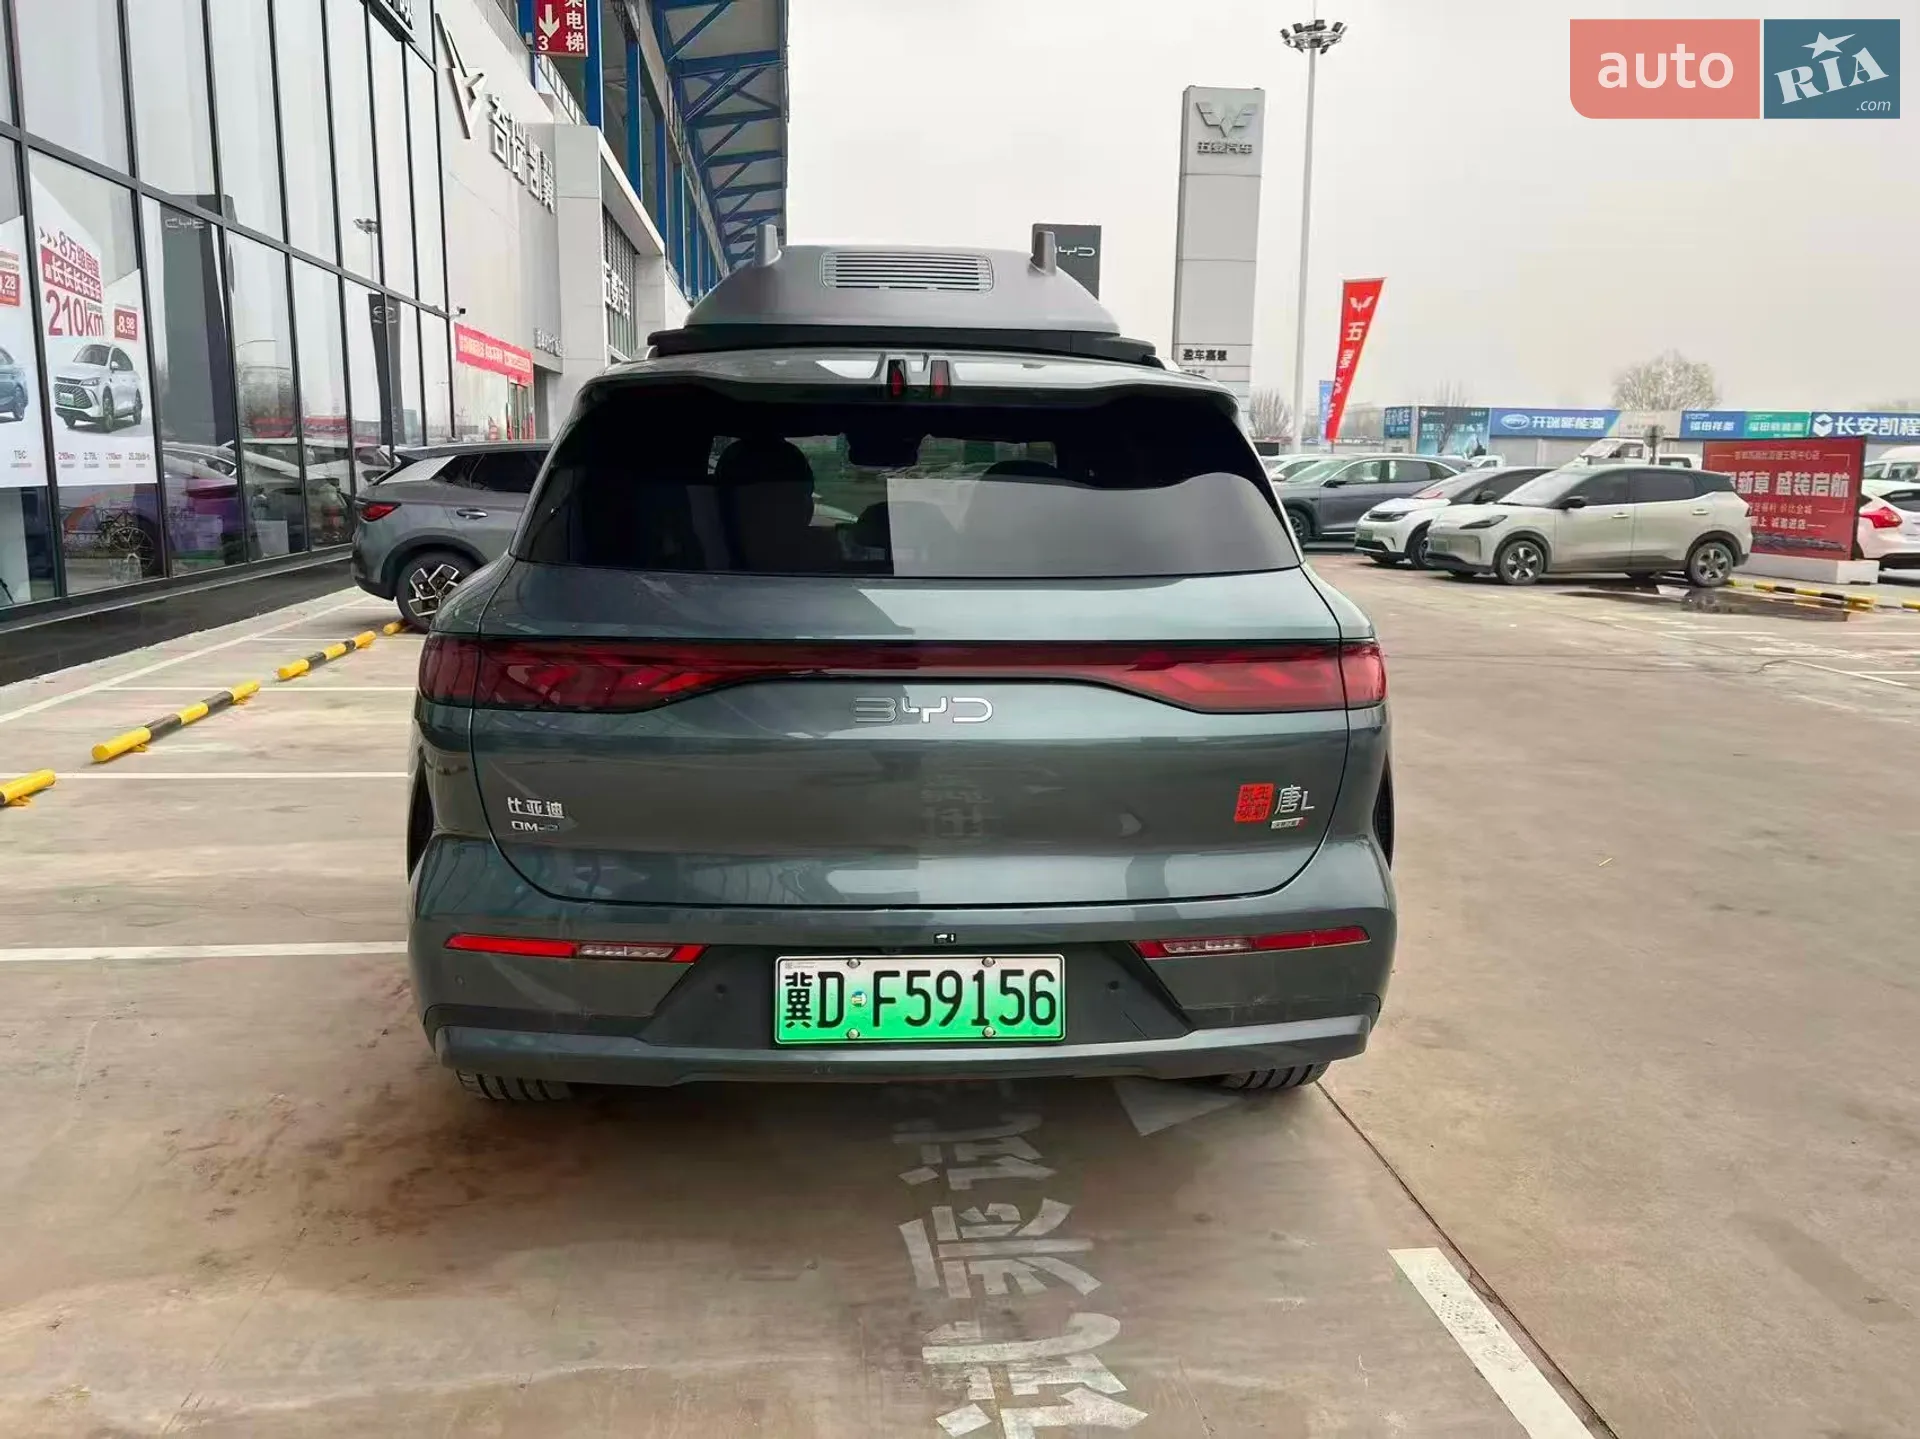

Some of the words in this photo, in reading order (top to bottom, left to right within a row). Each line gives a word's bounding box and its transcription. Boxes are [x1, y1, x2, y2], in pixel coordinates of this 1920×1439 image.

[538, 35, 549, 51] 3
[1054, 246, 1096, 257] YD
[0, 275, 17, 292] .28
[46, 289, 105, 336] 210km
[1835, 416, 1920, 436] 长安凯程
[853, 696, 994, 724] BYD
[507, 796, 566, 819] 比亚迪
[785, 971, 845, 1029] 冀D
[872, 969, 1057, 1028] F59156
